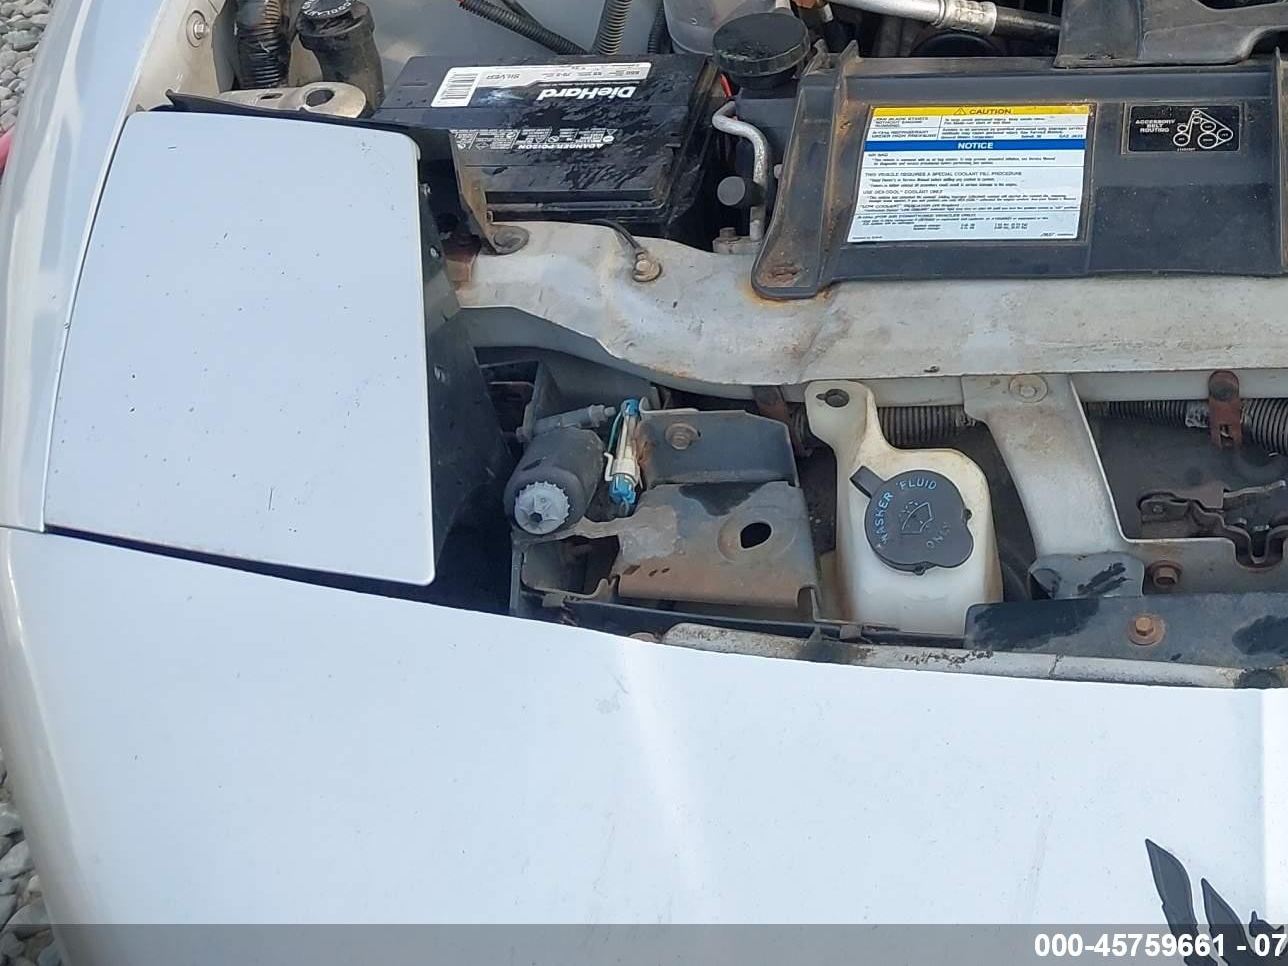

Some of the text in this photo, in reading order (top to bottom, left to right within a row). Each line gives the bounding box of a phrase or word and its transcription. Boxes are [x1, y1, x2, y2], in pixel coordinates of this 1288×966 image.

[536, 86, 637, 101] DieHard
[874, 478, 937, 545] WASHER FLUID
